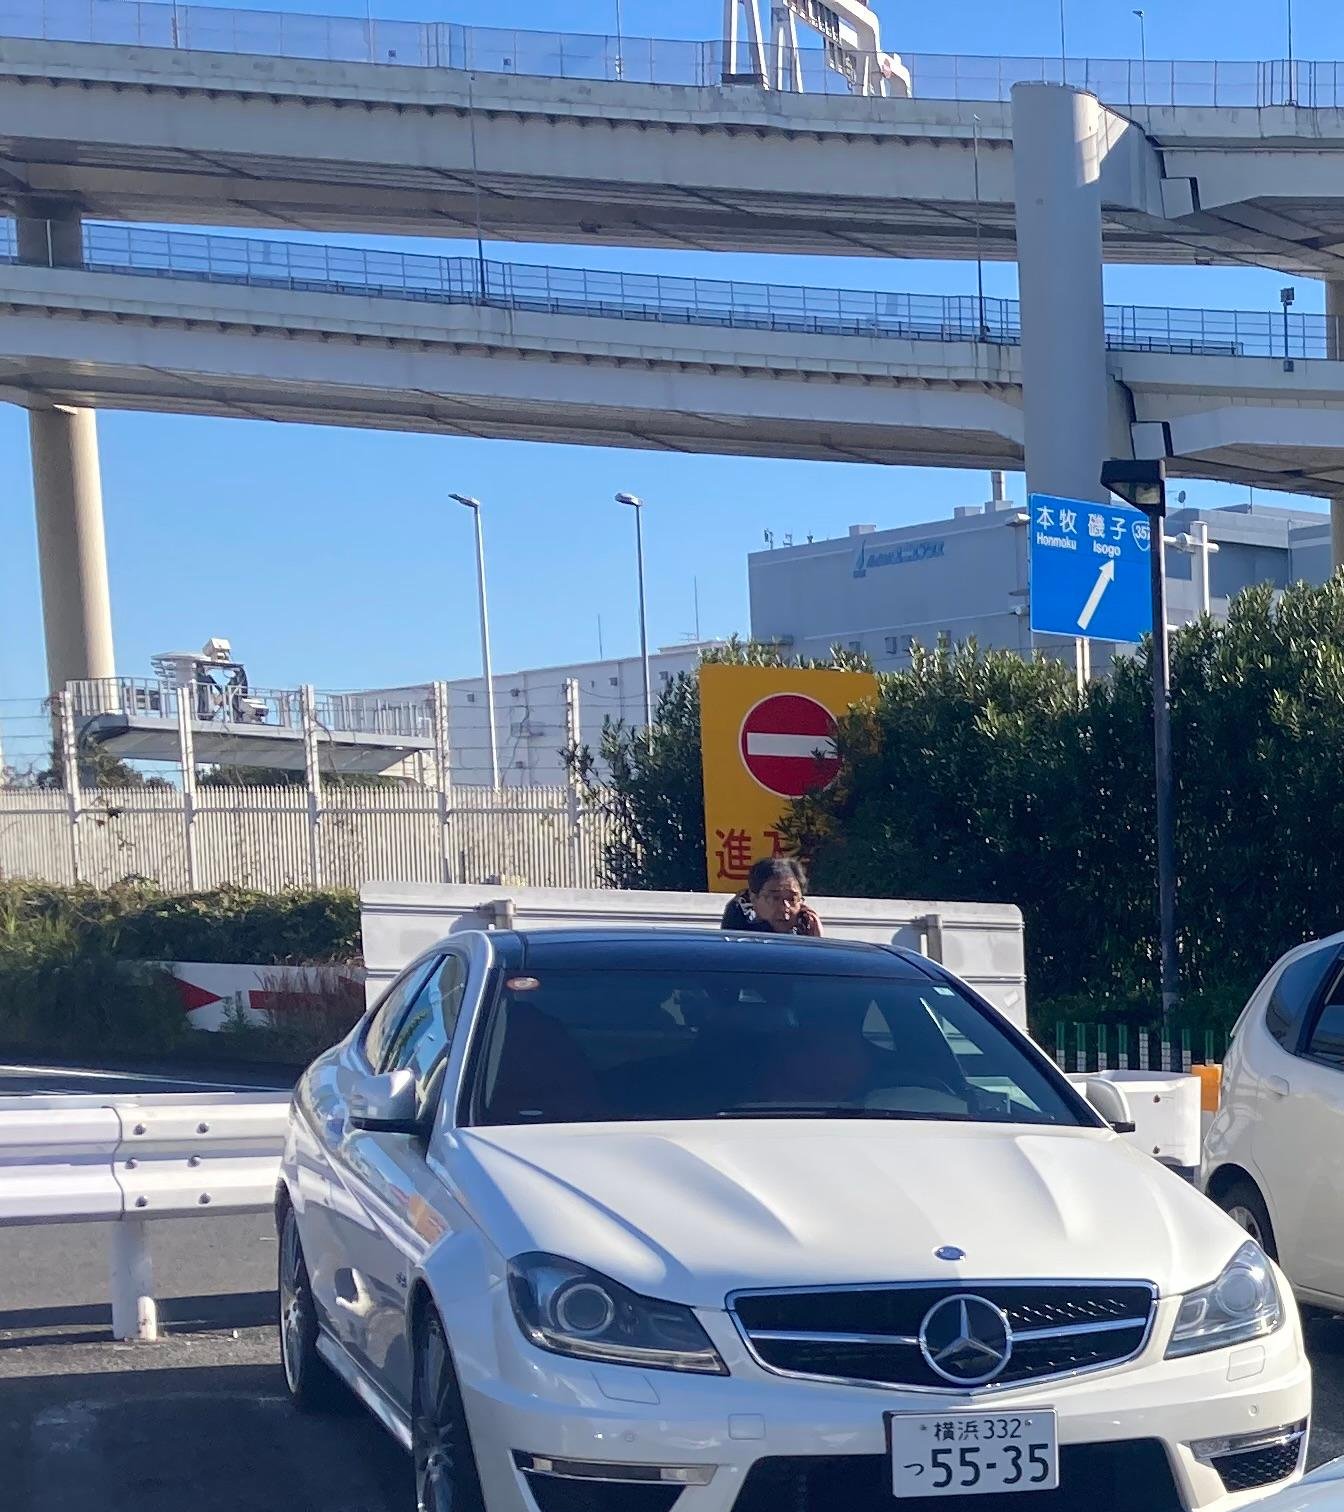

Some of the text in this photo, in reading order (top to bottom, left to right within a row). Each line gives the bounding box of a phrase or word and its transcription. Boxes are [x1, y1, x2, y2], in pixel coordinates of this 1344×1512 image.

[1036, 505, 1078, 534] 本牧
[1087, 513, 1127, 541] 磯子
[1036, 532, 1121, 558] Honmoku Isogo
